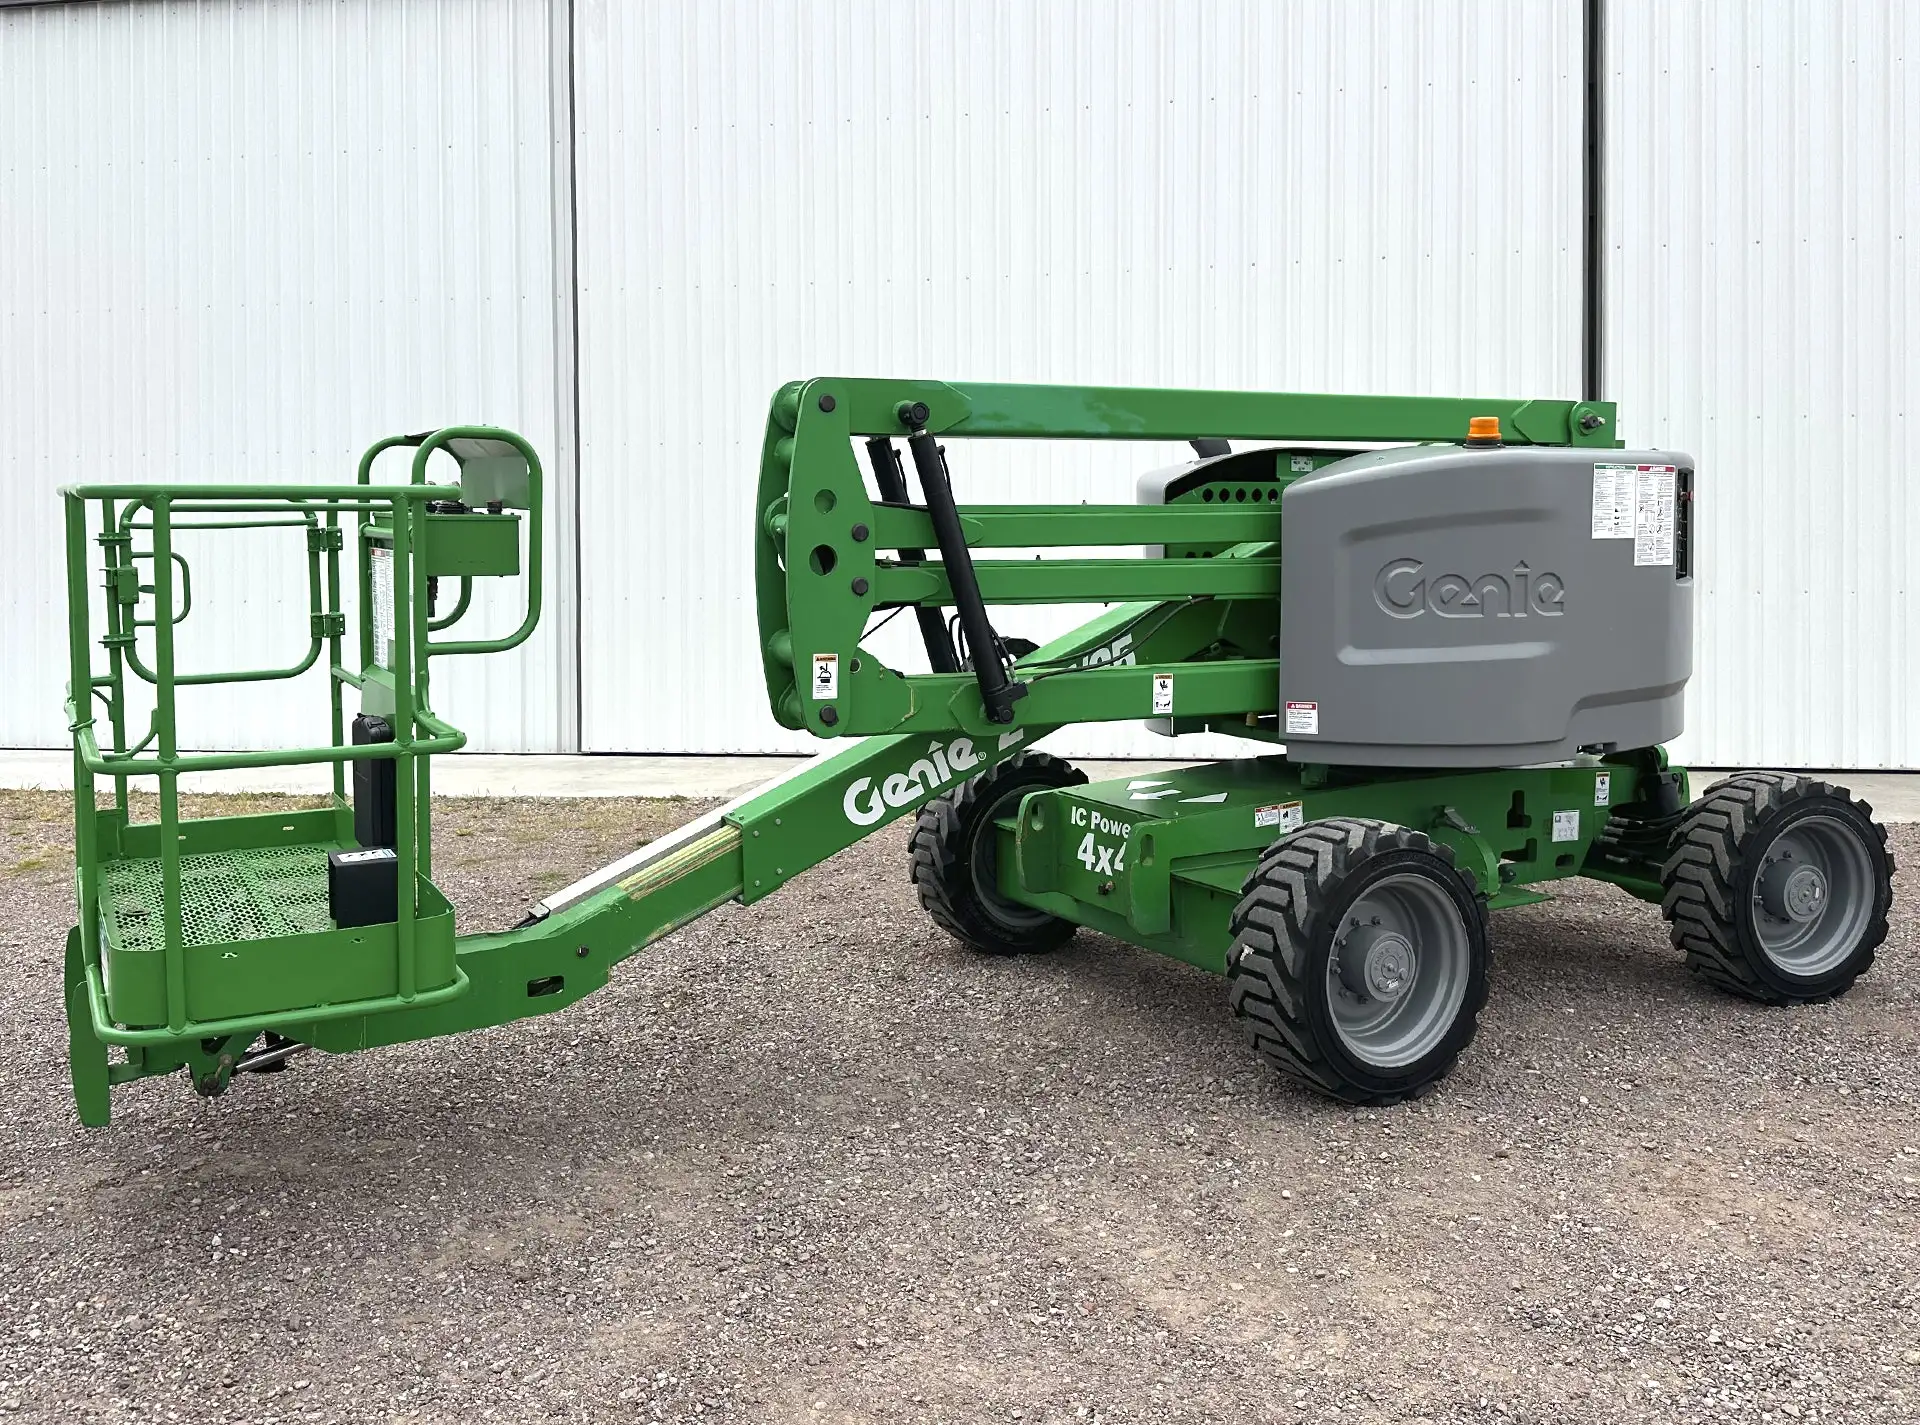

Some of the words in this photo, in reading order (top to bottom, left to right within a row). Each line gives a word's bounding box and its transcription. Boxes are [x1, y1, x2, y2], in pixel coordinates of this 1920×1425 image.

[1373, 557, 1564, 619] Genie
[843, 737, 979, 826] Genie
[1071, 806, 1087, 826] IC
[1091, 811, 1131, 838] Powe
